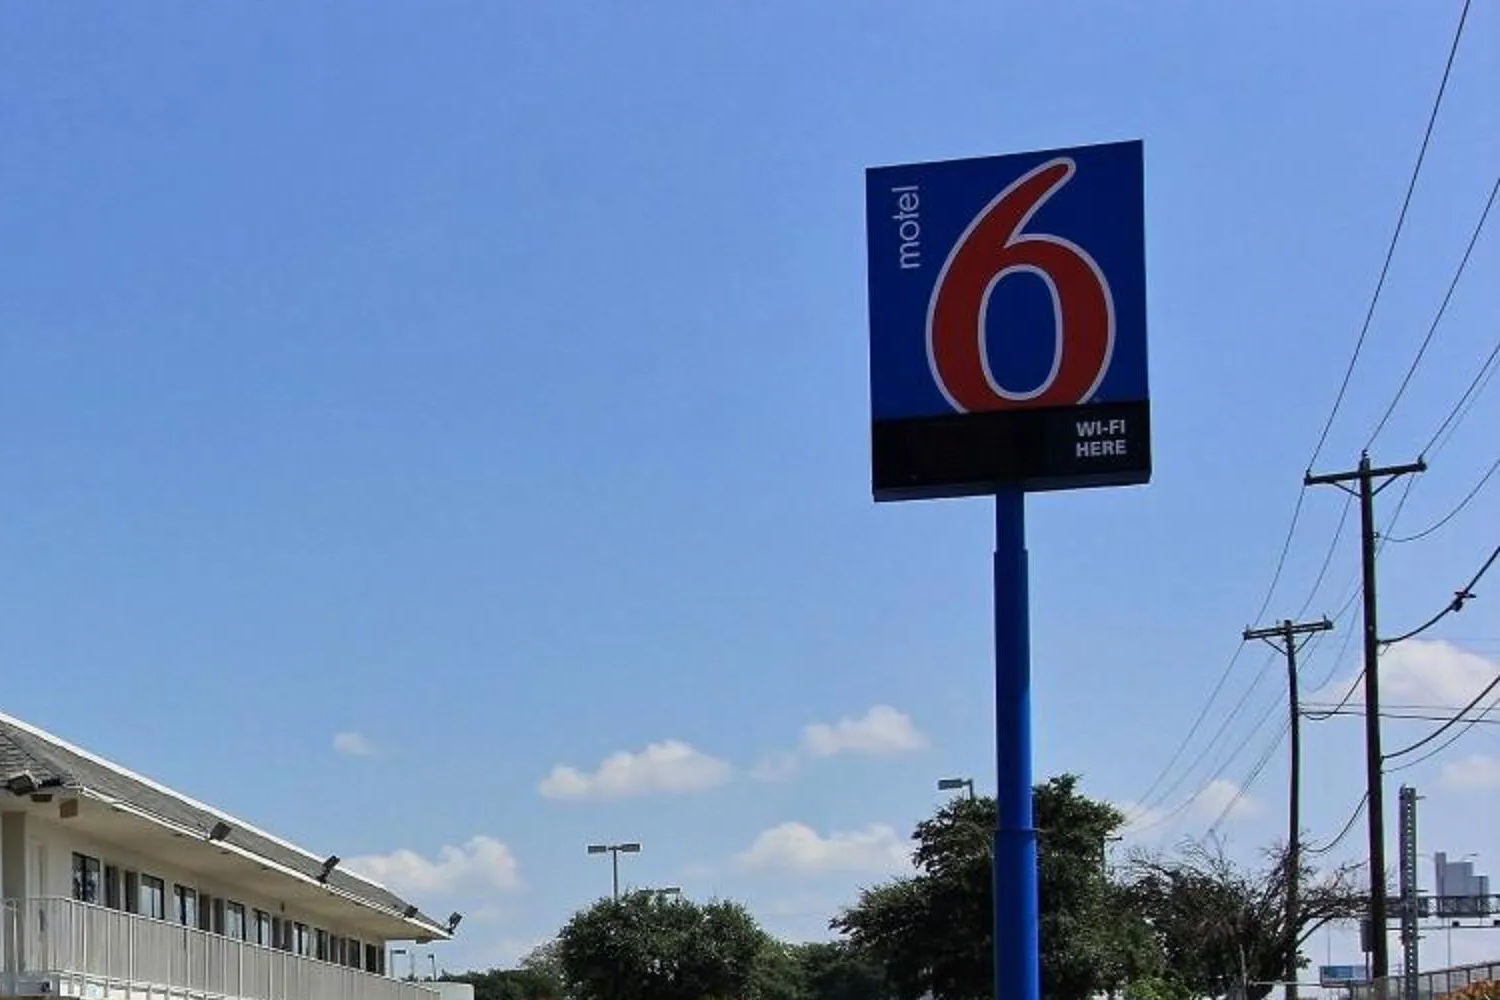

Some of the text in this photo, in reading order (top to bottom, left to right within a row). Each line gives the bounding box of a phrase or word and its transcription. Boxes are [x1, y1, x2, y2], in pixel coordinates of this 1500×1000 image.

[891, 185, 920, 268] motel
[925, 156, 1116, 414] 6
[1076, 419, 1125, 437] WI-FI
[1076, 439, 1127, 457] HERE
